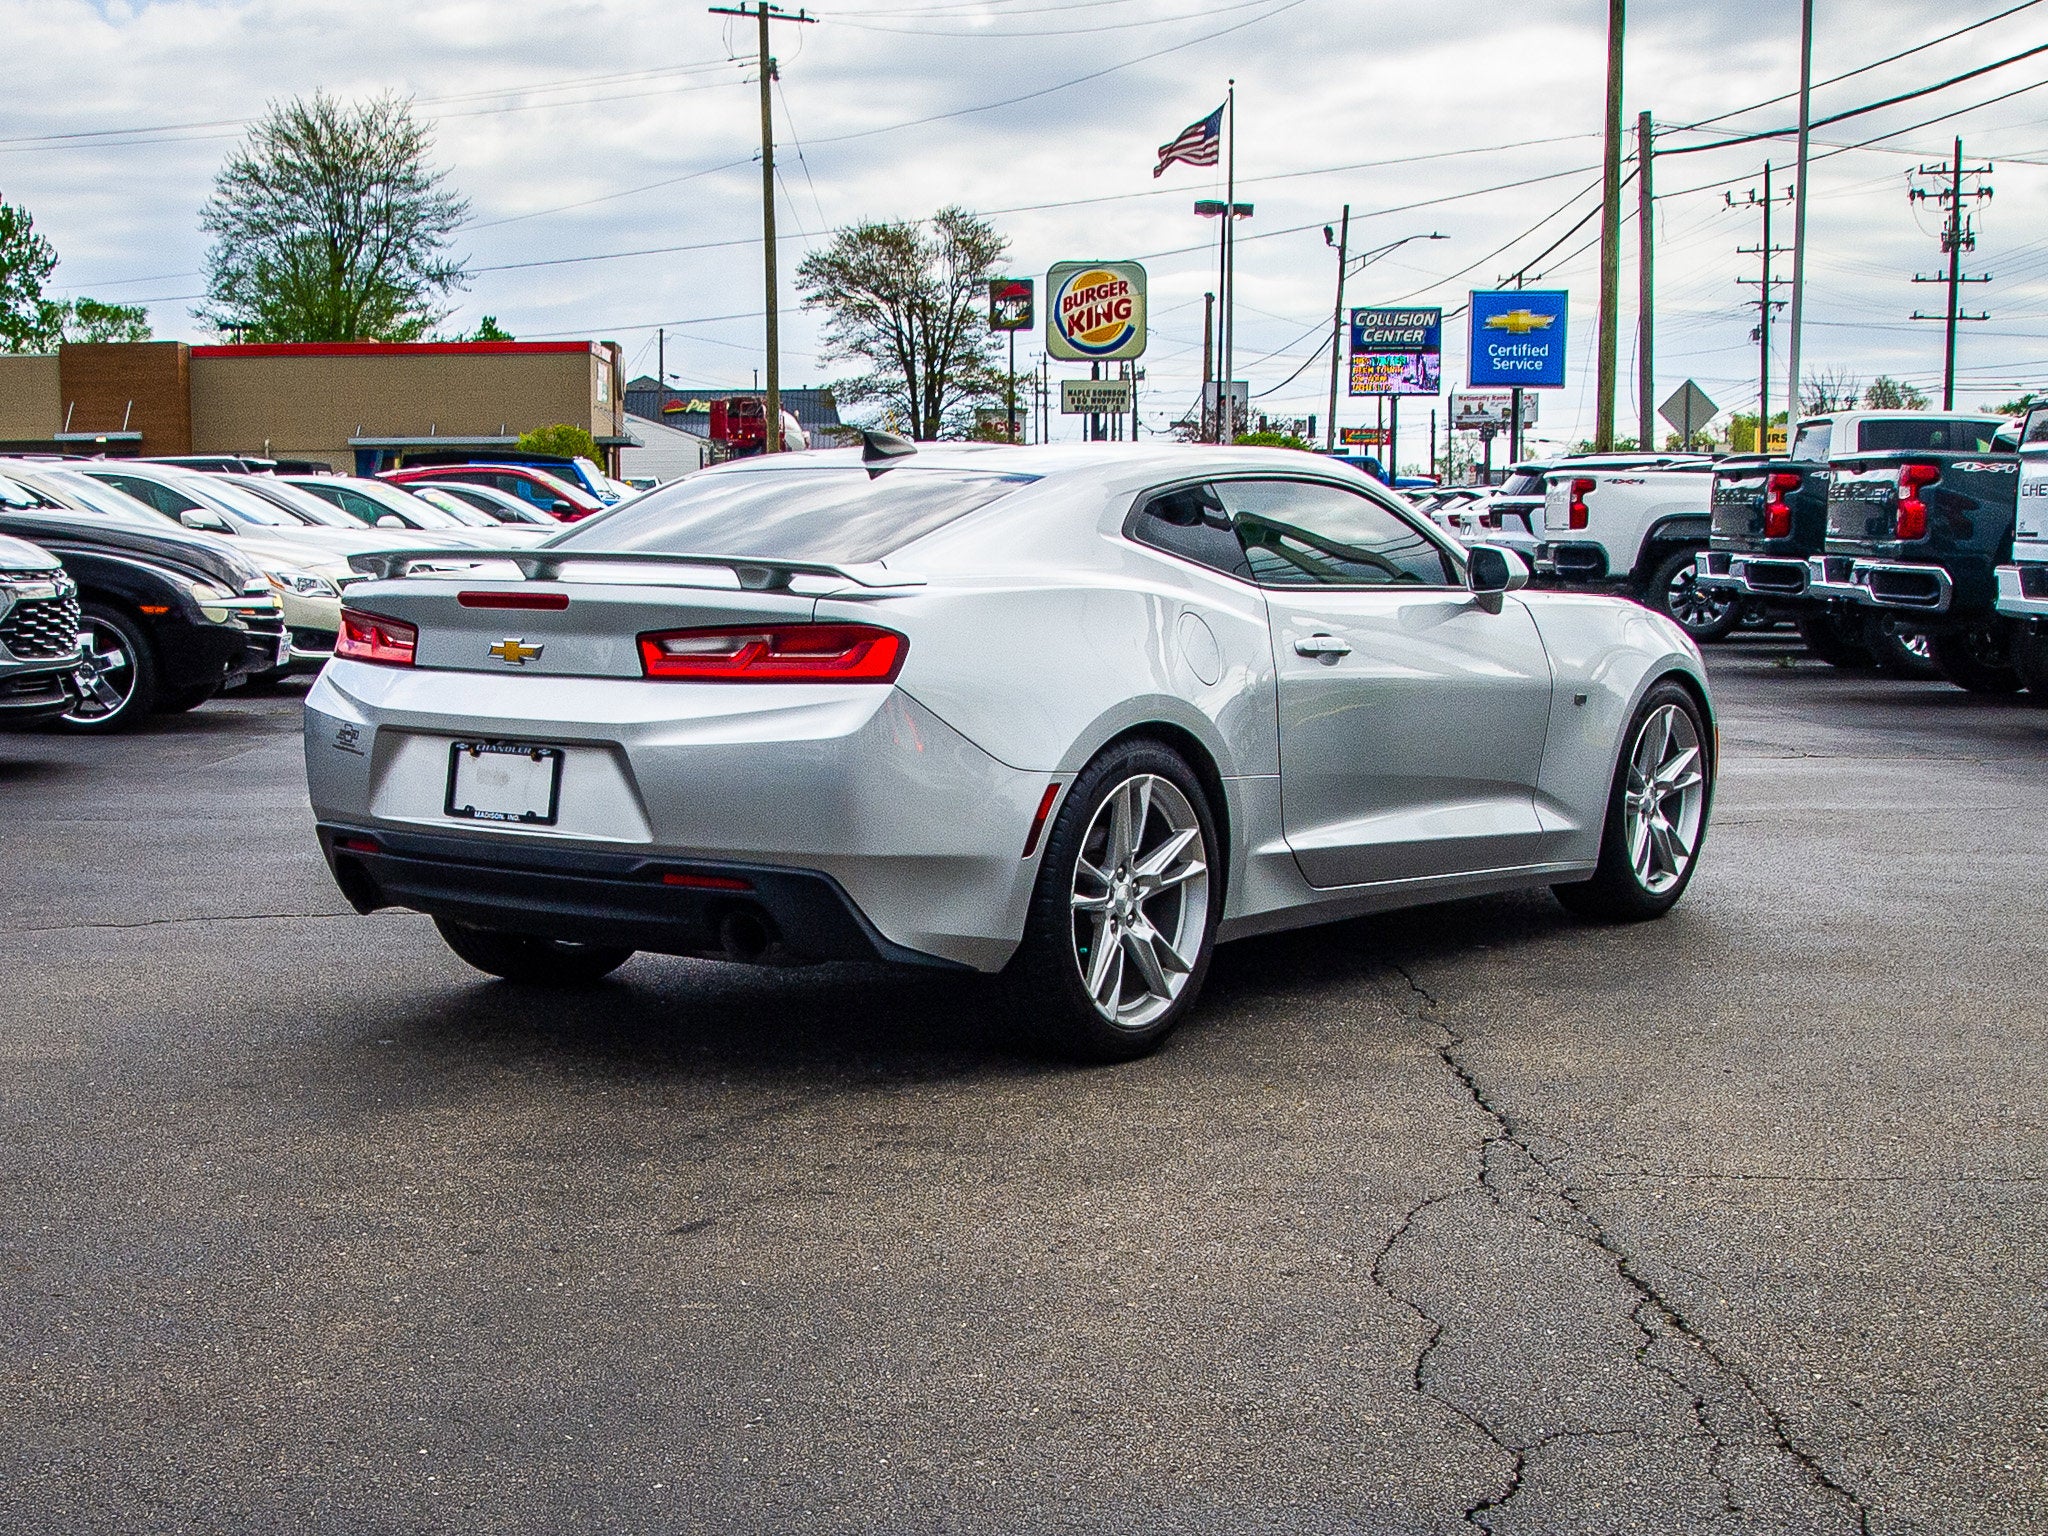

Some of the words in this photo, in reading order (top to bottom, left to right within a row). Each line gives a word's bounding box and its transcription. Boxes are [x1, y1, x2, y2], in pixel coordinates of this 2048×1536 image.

[1062, 280, 1129, 315] BURGER
[1066, 298, 1133, 338] KING
[1355, 311, 1436, 327] COLLISION
[1363, 328, 1425, 343] CENTER
[1488, 343, 1549, 358] Certified
[1492, 357, 1543, 371] Service
[1067, 389, 1090, 397] MAPLE
[1092, 389, 1127, 397] BOURBON
[1090, 397, 1125, 405] WHOPPER
[475, 744, 532, 754] CHANDLER
